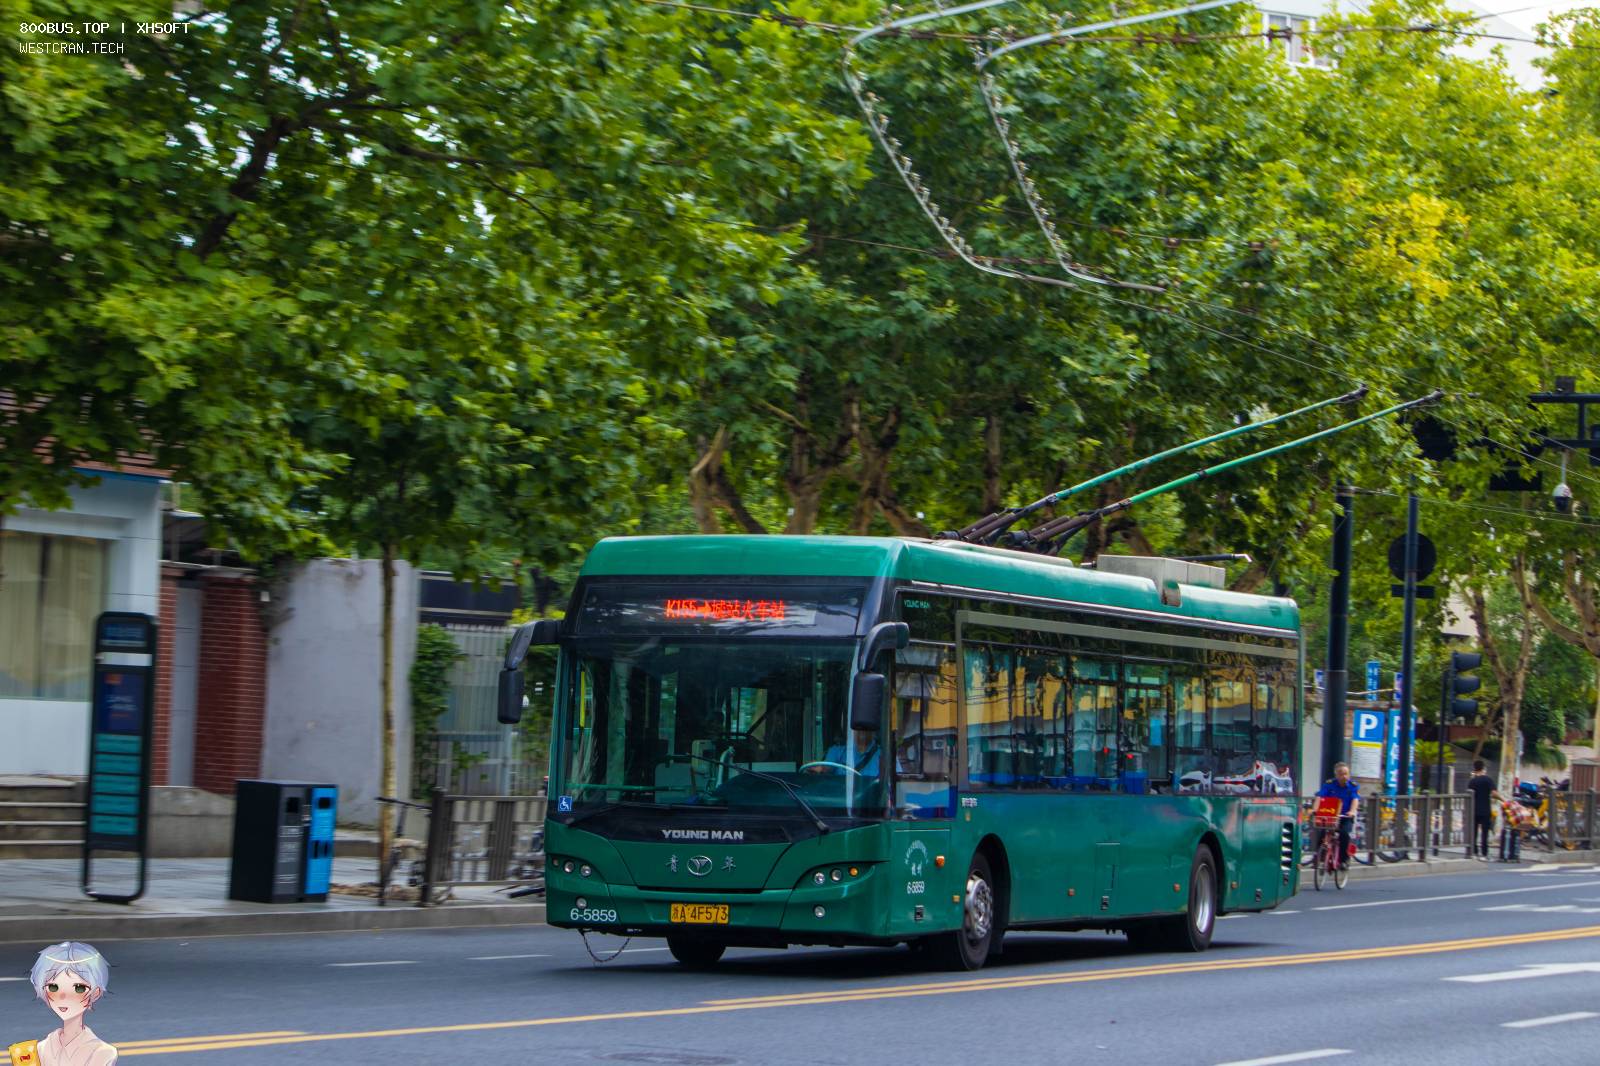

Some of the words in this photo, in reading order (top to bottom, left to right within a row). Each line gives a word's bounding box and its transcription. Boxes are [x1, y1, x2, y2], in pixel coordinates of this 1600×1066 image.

[1358, 713, 1379, 739] P
[662, 829, 709, 839] YOUNG
[711, 829, 744, 840] MAN
[906, 880, 925, 894] 6-5859
[570, 907, 617, 922] 6-5859
